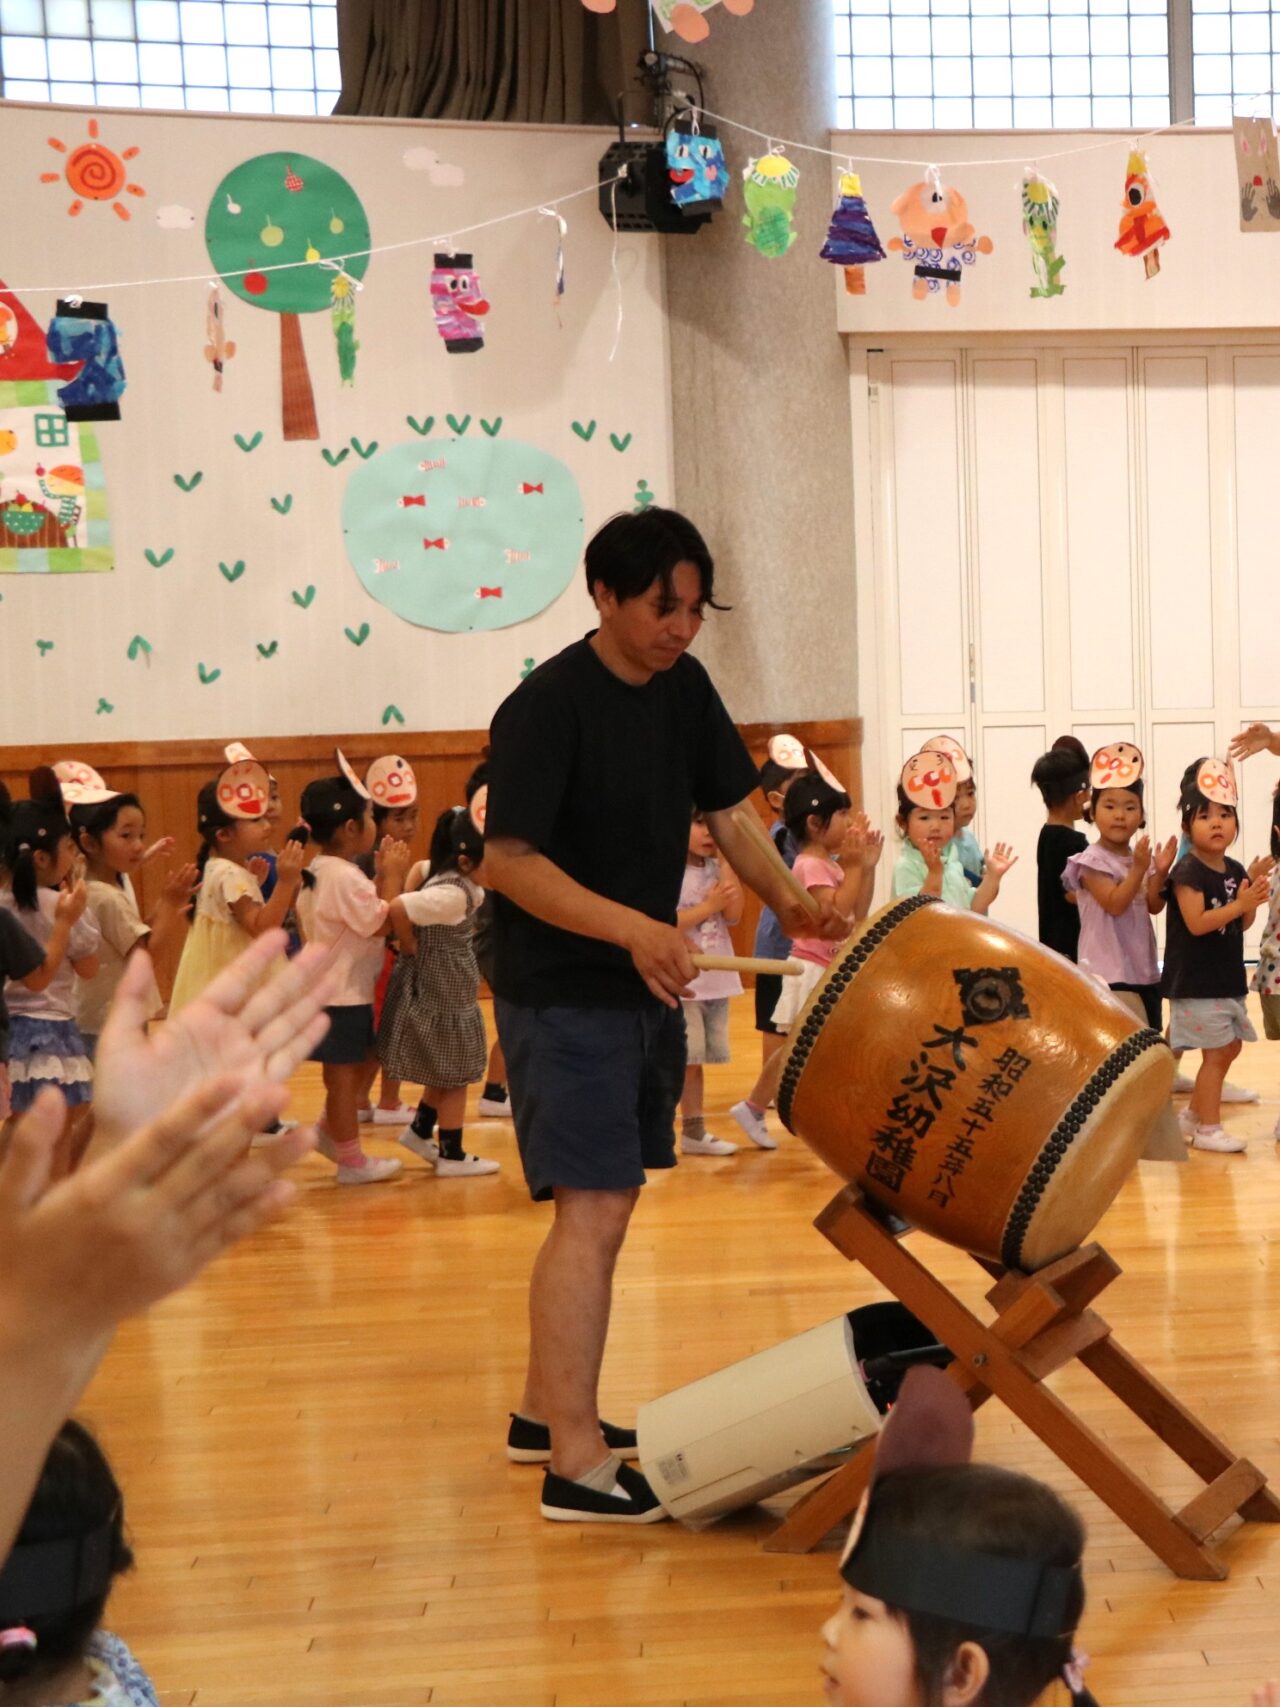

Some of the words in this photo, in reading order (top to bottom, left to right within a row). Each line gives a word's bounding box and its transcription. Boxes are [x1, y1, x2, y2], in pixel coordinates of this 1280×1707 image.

[865, 1023, 979, 1194] 大沢幼稚園
